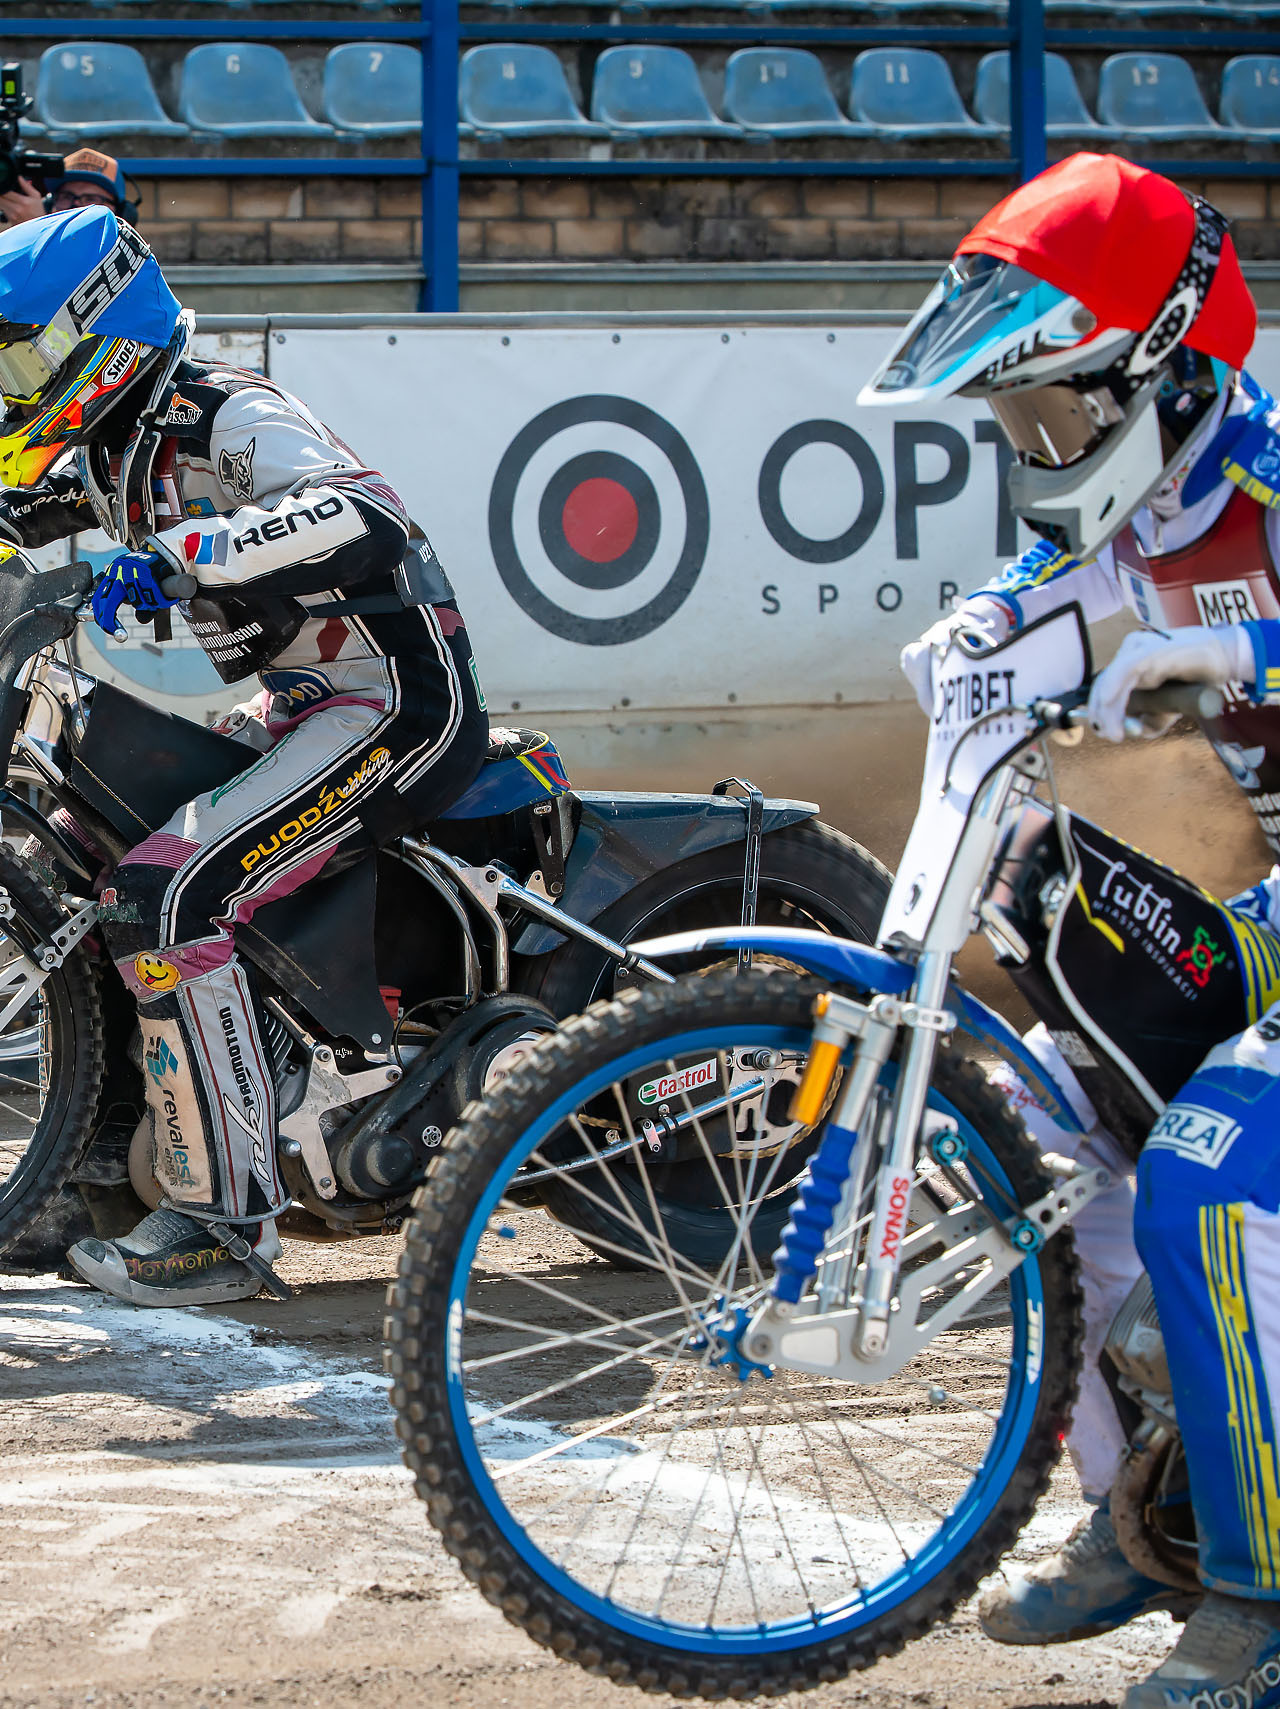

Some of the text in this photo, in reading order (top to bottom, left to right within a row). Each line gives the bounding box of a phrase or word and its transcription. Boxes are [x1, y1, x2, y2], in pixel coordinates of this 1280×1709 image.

[80, 55, 95, 76] 5
[225, 54, 240, 73] 6
[369, 51, 384, 72] 7
[884, 62, 909, 84] 11
[1131, 64, 1160, 87] 13
[106, 339, 136, 380] SHOEI
[1200, 588, 1254, 628] MFR
[212, 645, 245, 664] Round
[219, 1006, 255, 1109] PROMOTION
[656, 1062, 714, 1099] Castrol
[162, 1088, 197, 1189] revalest
[878, 1175, 911, 1260] SONAX
